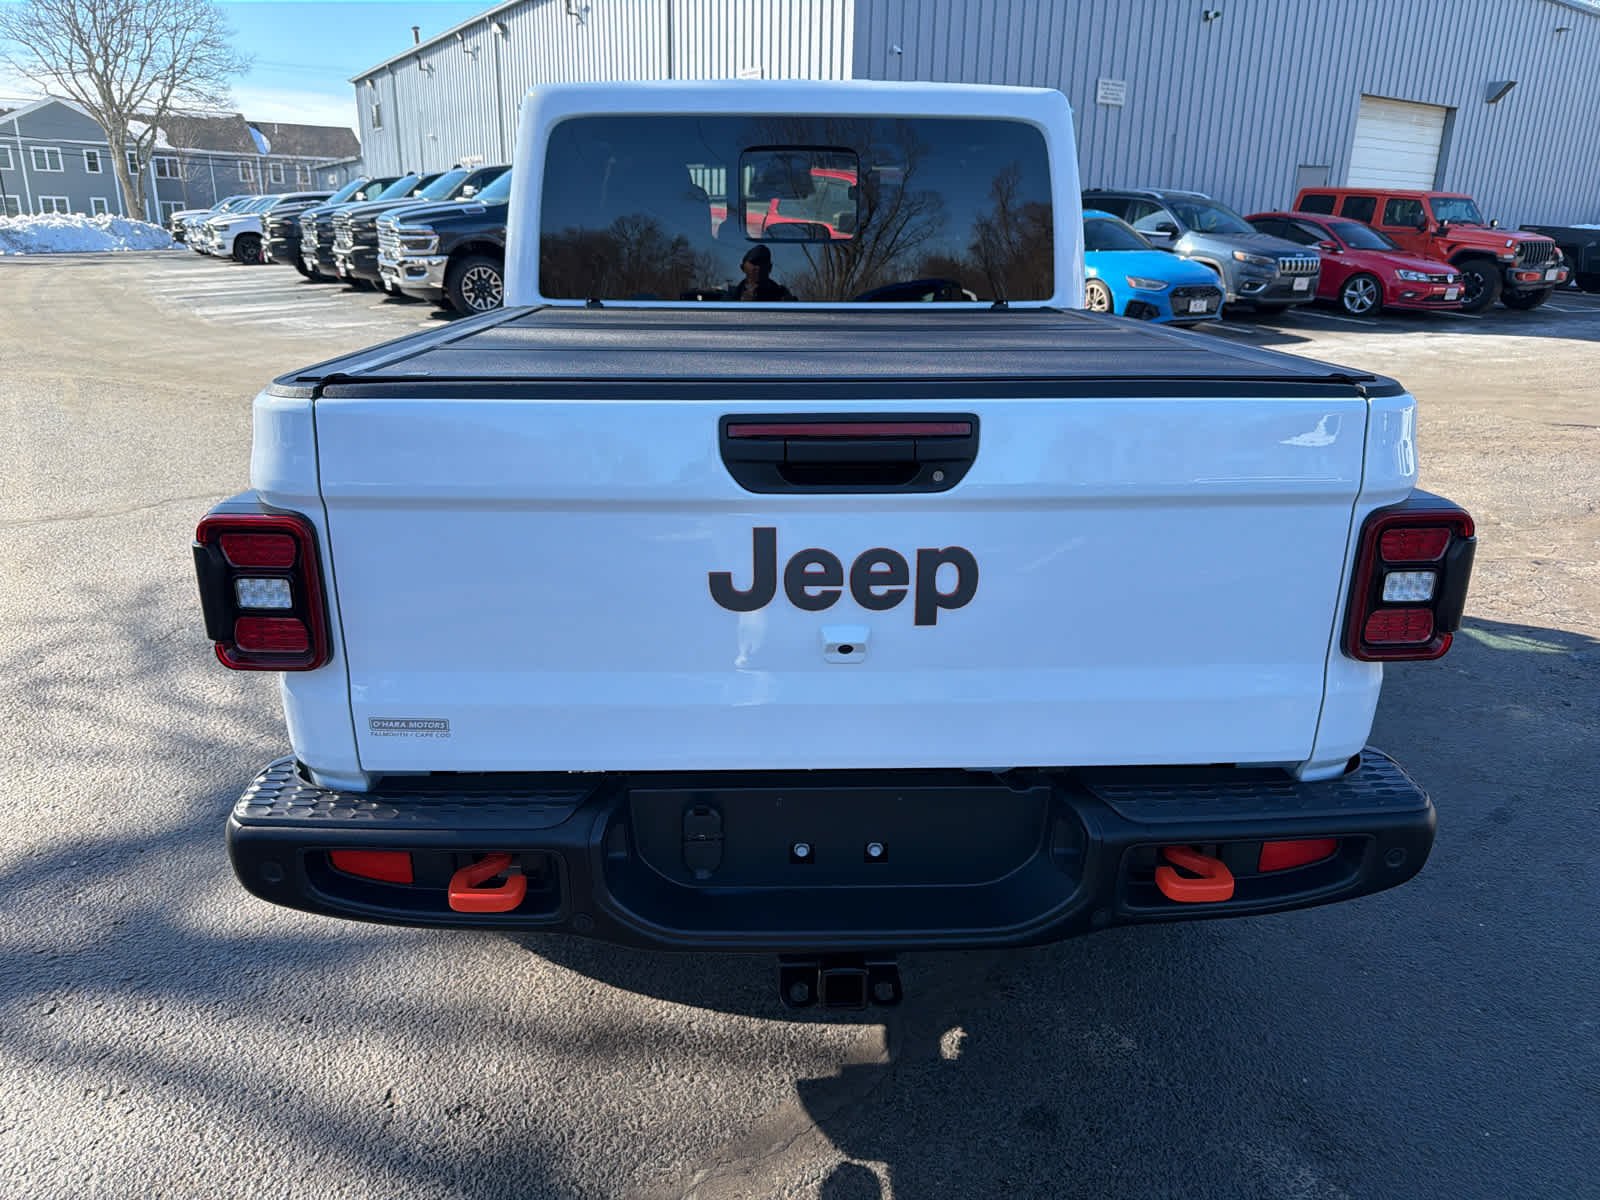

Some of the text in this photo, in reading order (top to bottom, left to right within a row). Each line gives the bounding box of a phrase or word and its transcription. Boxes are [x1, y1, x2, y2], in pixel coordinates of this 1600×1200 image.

[708, 526, 979, 626] Jeep
[373, 720, 446, 730] O'HARA MOTORS
